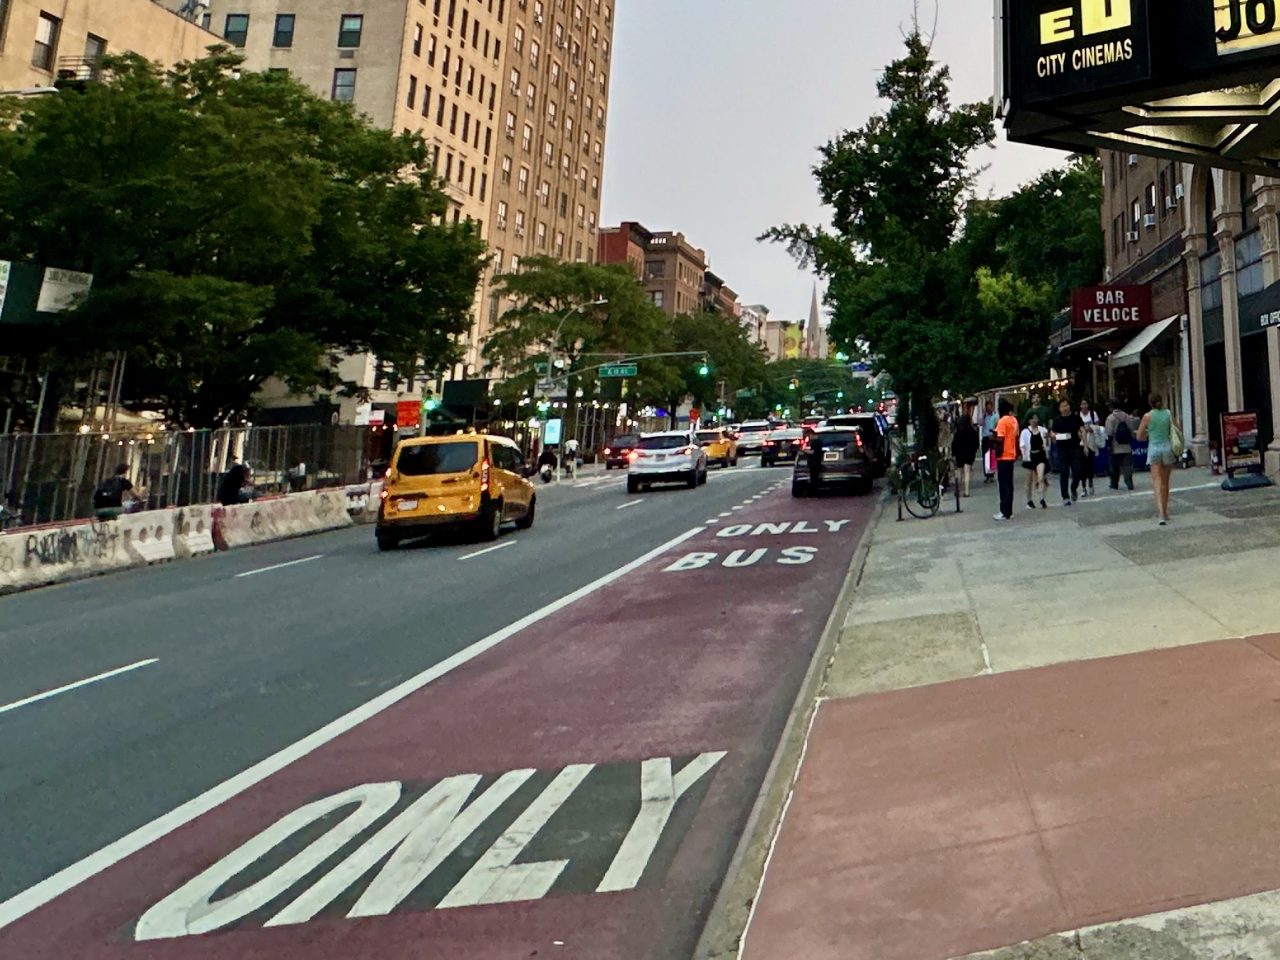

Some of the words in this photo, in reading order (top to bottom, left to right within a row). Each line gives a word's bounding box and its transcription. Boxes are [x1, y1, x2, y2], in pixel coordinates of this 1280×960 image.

[1036, 52, 1066, 78] CITY
[1072, 39, 1133, 72] CINEMAS
[1095, 290, 1125, 305] BAR
[1083, 306, 1140, 323] VELOCE
[716, 519, 851, 538] ONLY
[660, 546, 819, 572] BUS
[134, 750, 729, 941] ONLY
